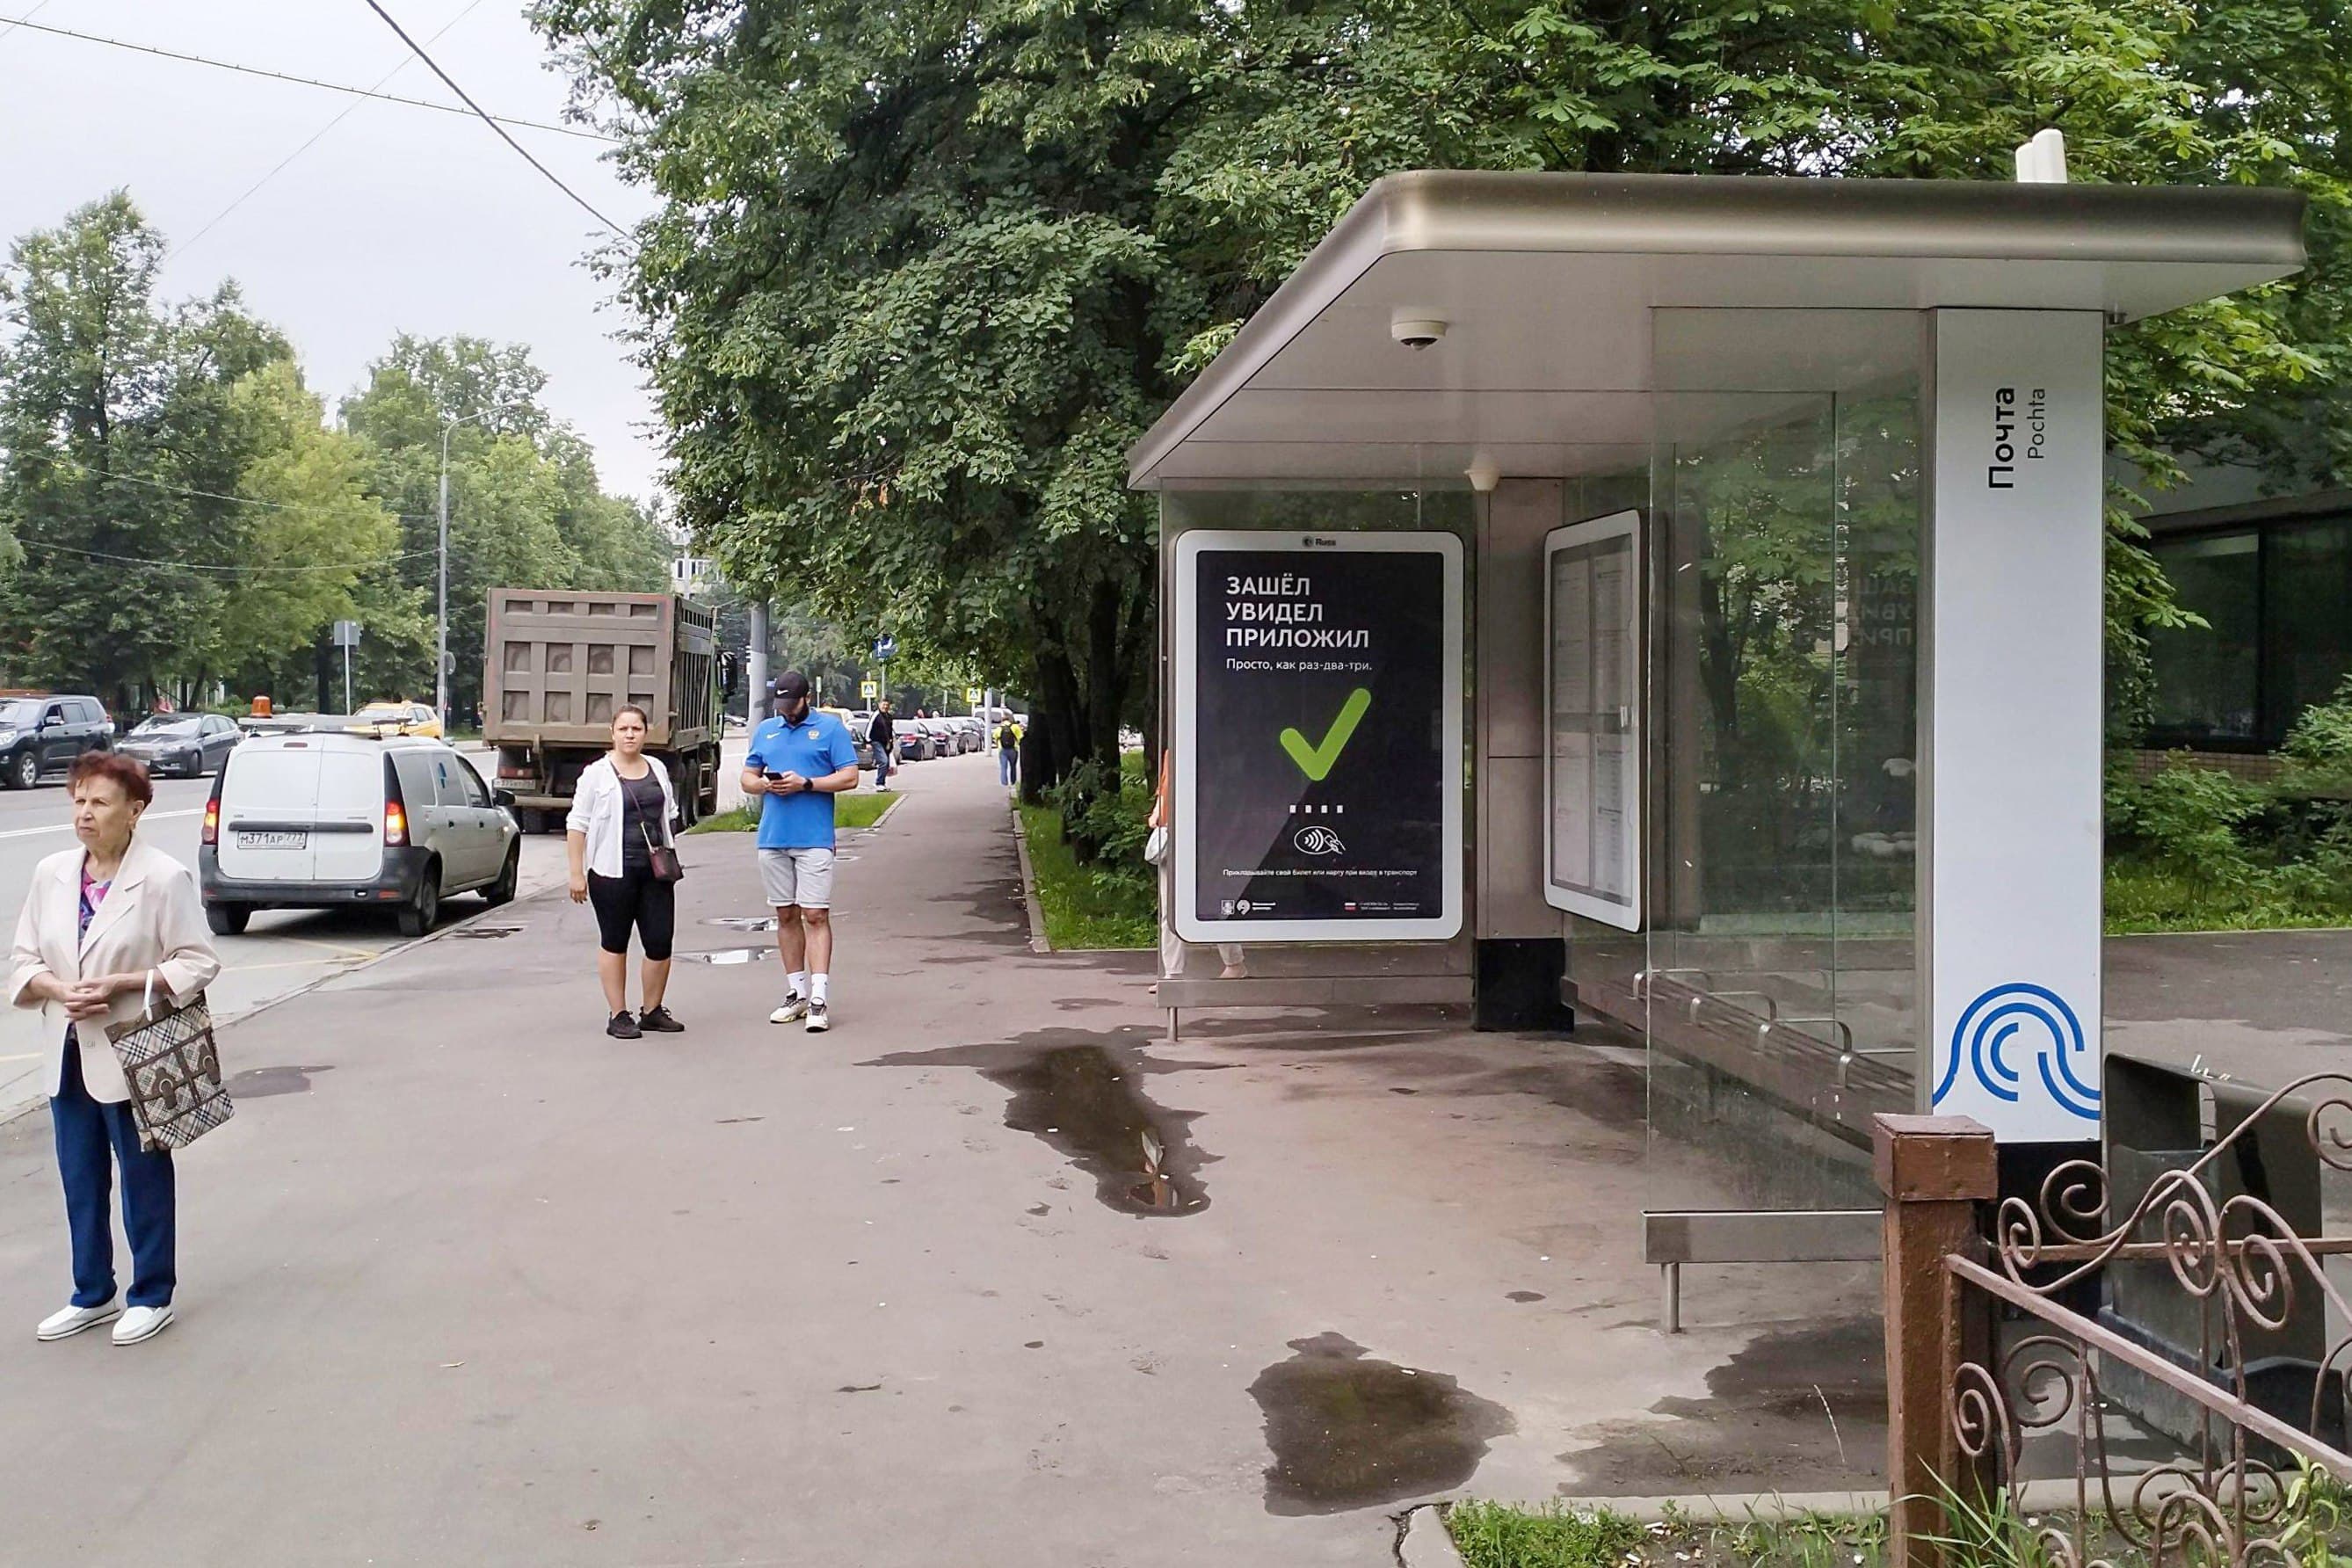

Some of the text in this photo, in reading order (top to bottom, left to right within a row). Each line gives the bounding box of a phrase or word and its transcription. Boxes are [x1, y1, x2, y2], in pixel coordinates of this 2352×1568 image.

[2026, 388, 2045, 459] Pochta
[1988, 388, 2014, 489] Почта
[1226, 573, 1310, 596] ЗАШЁЛ
[1225, 602, 1324, 624] УВИДЕЛ
[1226, 628, 1369, 649] ПРИЛОЖИЛ
[1226, 658, 1373, 672] Просто, как раз-два-три.
